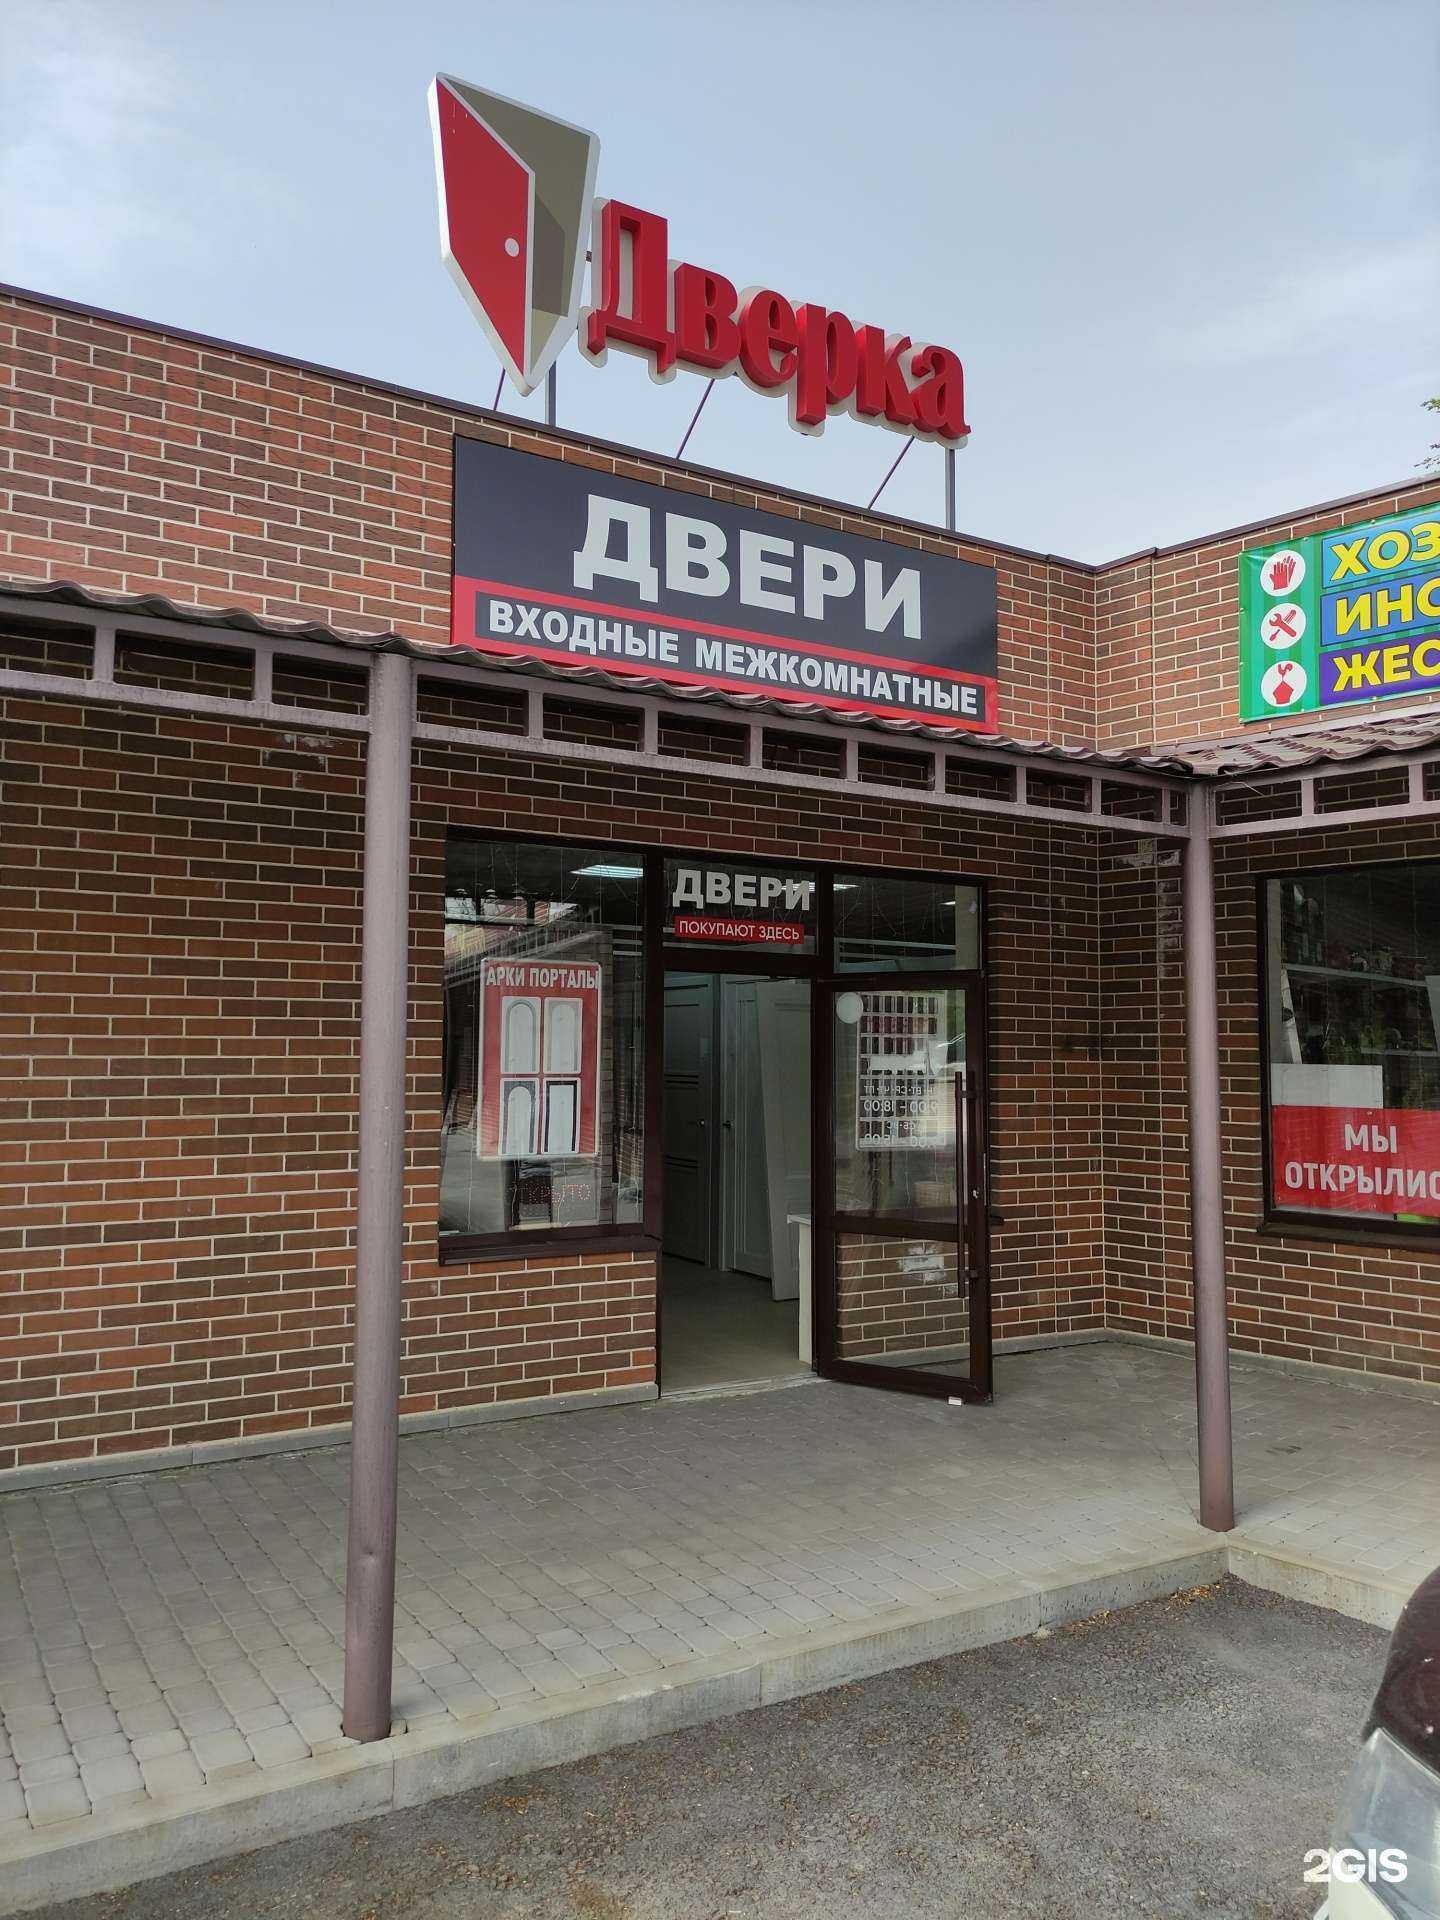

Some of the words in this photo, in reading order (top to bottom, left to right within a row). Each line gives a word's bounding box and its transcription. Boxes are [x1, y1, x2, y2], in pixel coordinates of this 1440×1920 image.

[582, 198, 972, 443] Дверка
[573, 493, 921, 640] ДВЕРИ
[1330, 521, 1440, 582] ХОЗ
[489, 600, 679, 664] ВХОДНЫЕ
[695, 638, 978, 715] МЕЖКОМНАТНЫЕ
[672, 868, 810, 911] ДВЕРИ
[679, 920, 756, 938] ПОКУПАЮТ
[758, 925, 800, 941] ЗДЕСЬ
[486, 966, 525, 987] АРКИ
[529, 967, 599, 989] ПОРТАЛЫ
[1344, 1123, 1398, 1153] МЫ
